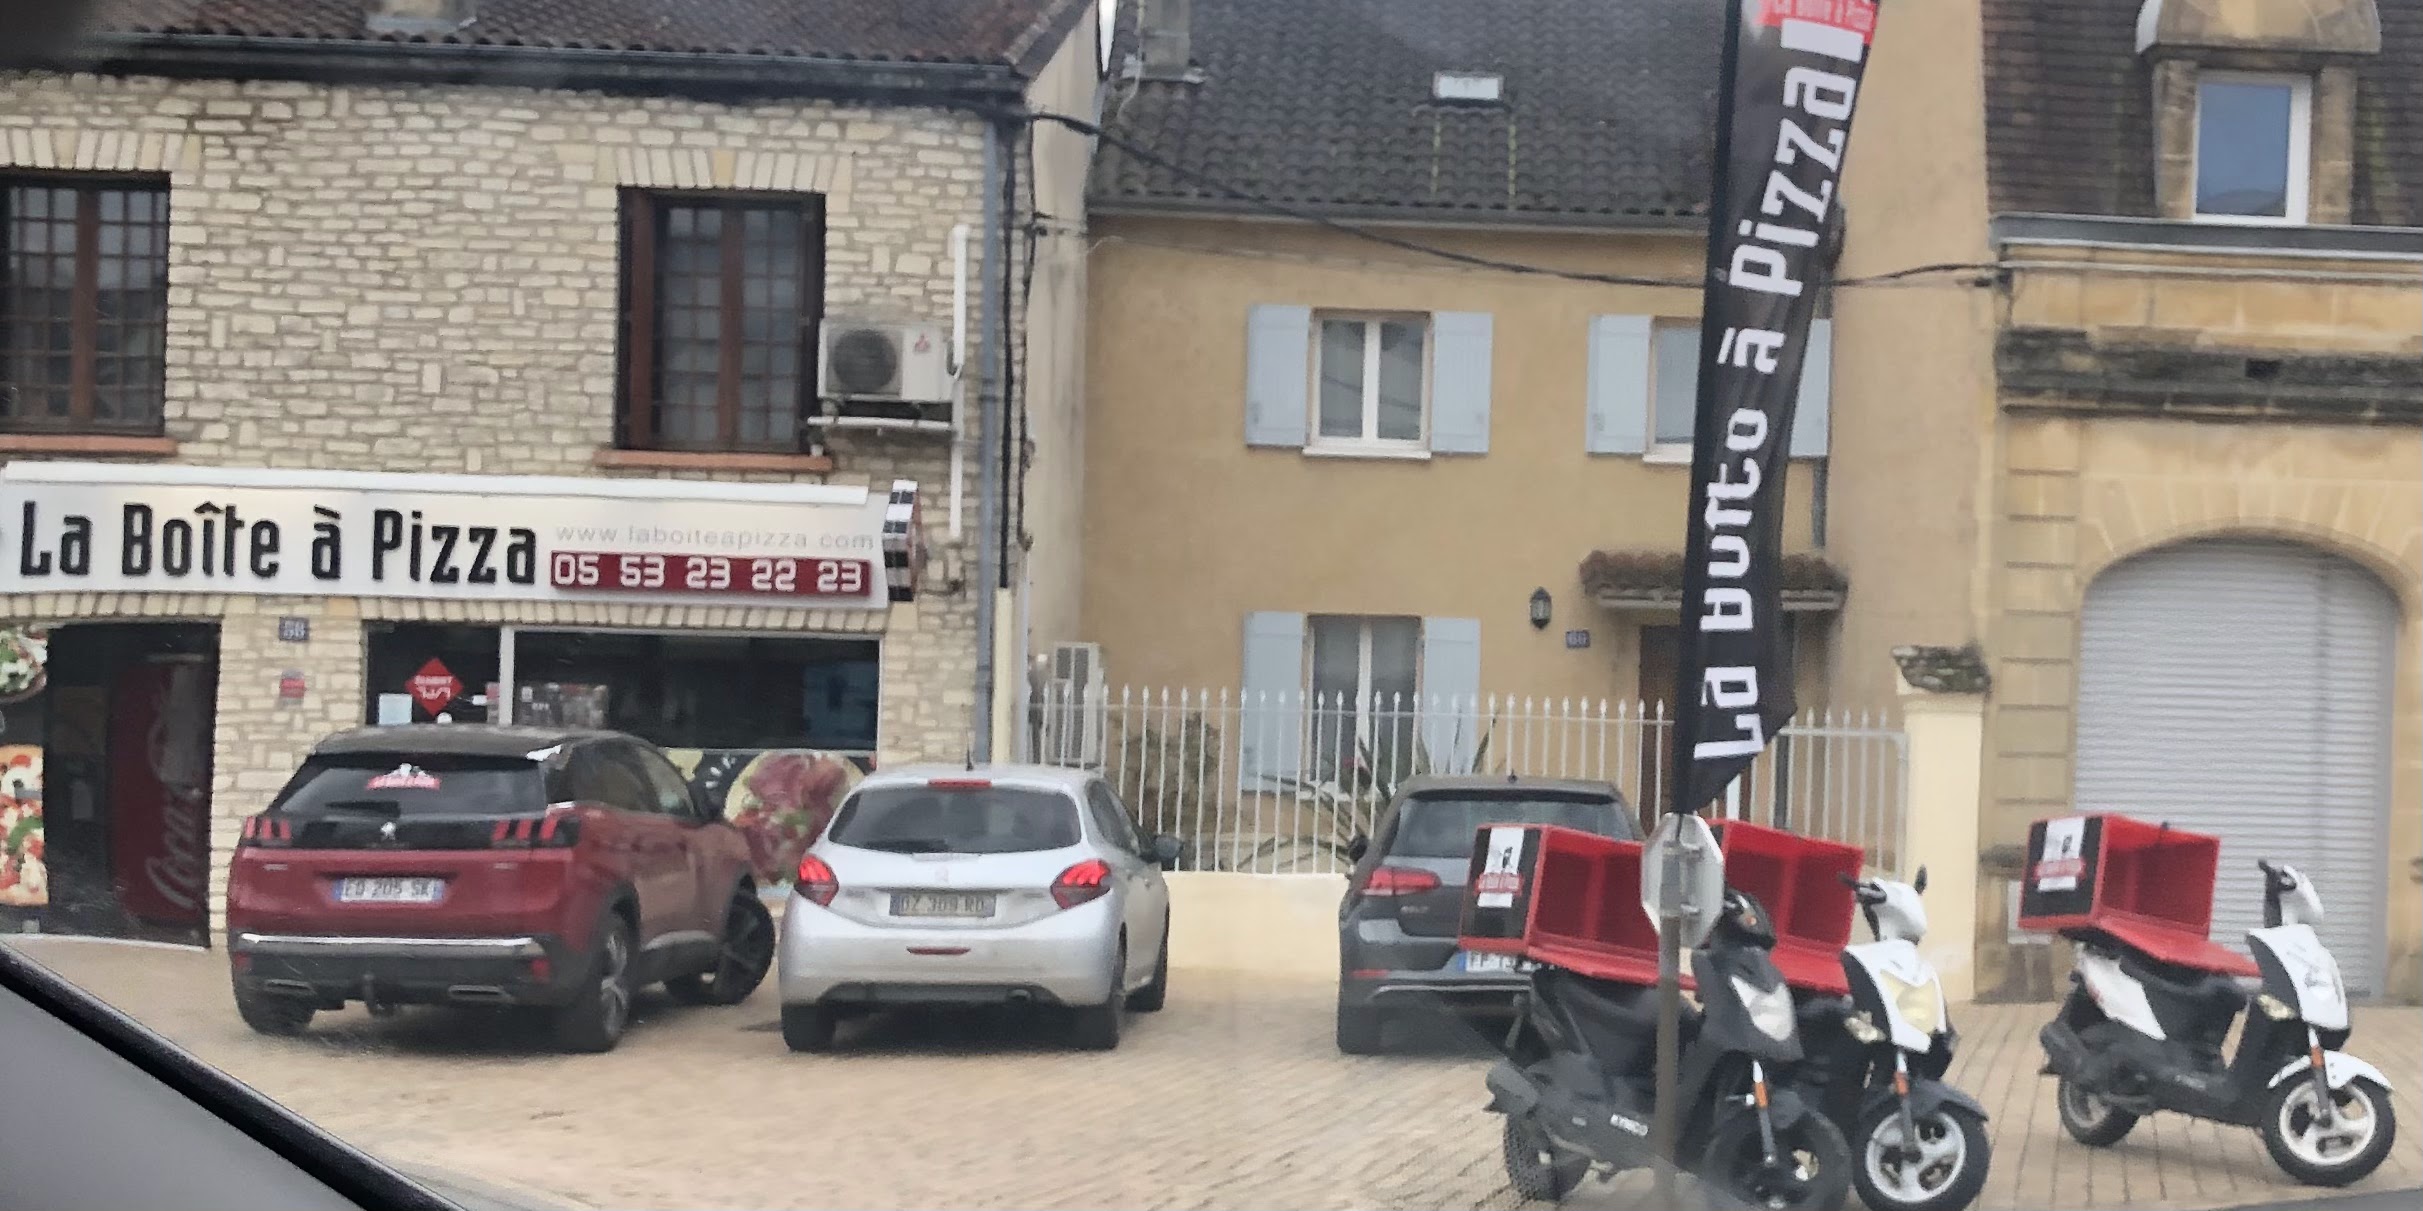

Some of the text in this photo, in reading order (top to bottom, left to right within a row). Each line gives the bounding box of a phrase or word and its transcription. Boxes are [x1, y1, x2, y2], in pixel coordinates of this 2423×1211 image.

[1729, 66, 1857, 297] Pizza
[20, 500, 537, 585] La Boîte à Pizza
[554, 553, 862, 592] 05 53 23 22 23
[1694, 666, 1766, 759] La
